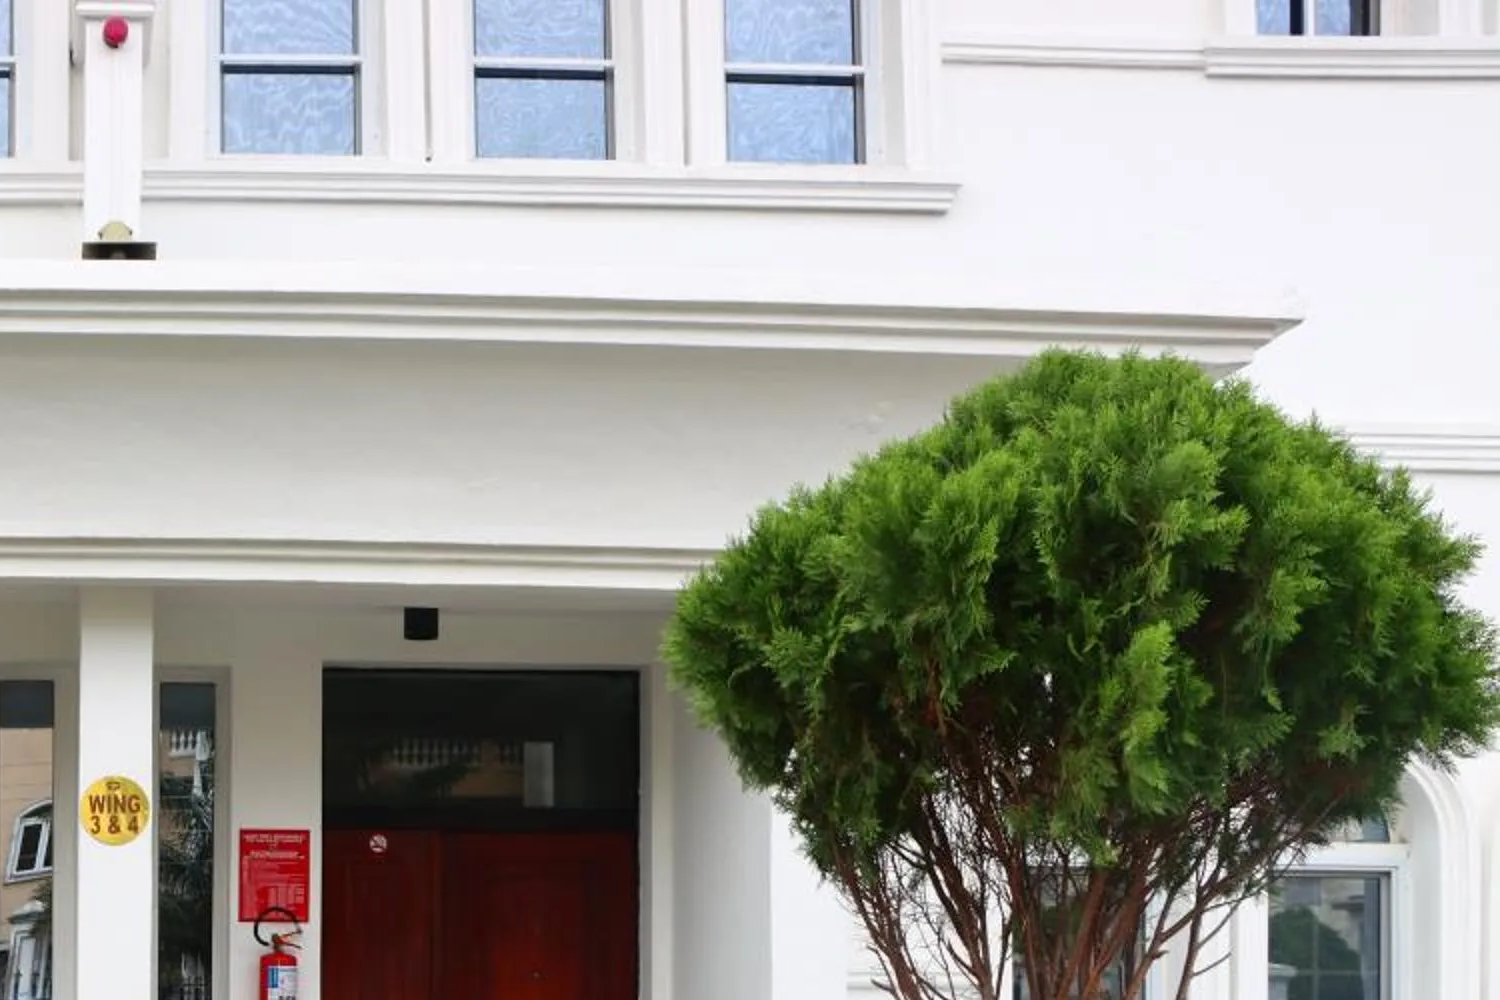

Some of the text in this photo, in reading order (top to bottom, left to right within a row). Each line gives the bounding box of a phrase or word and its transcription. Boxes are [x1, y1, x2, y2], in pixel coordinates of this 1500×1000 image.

[89, 794, 141, 813] WING
[91, 815, 139, 834] 3 & 4
